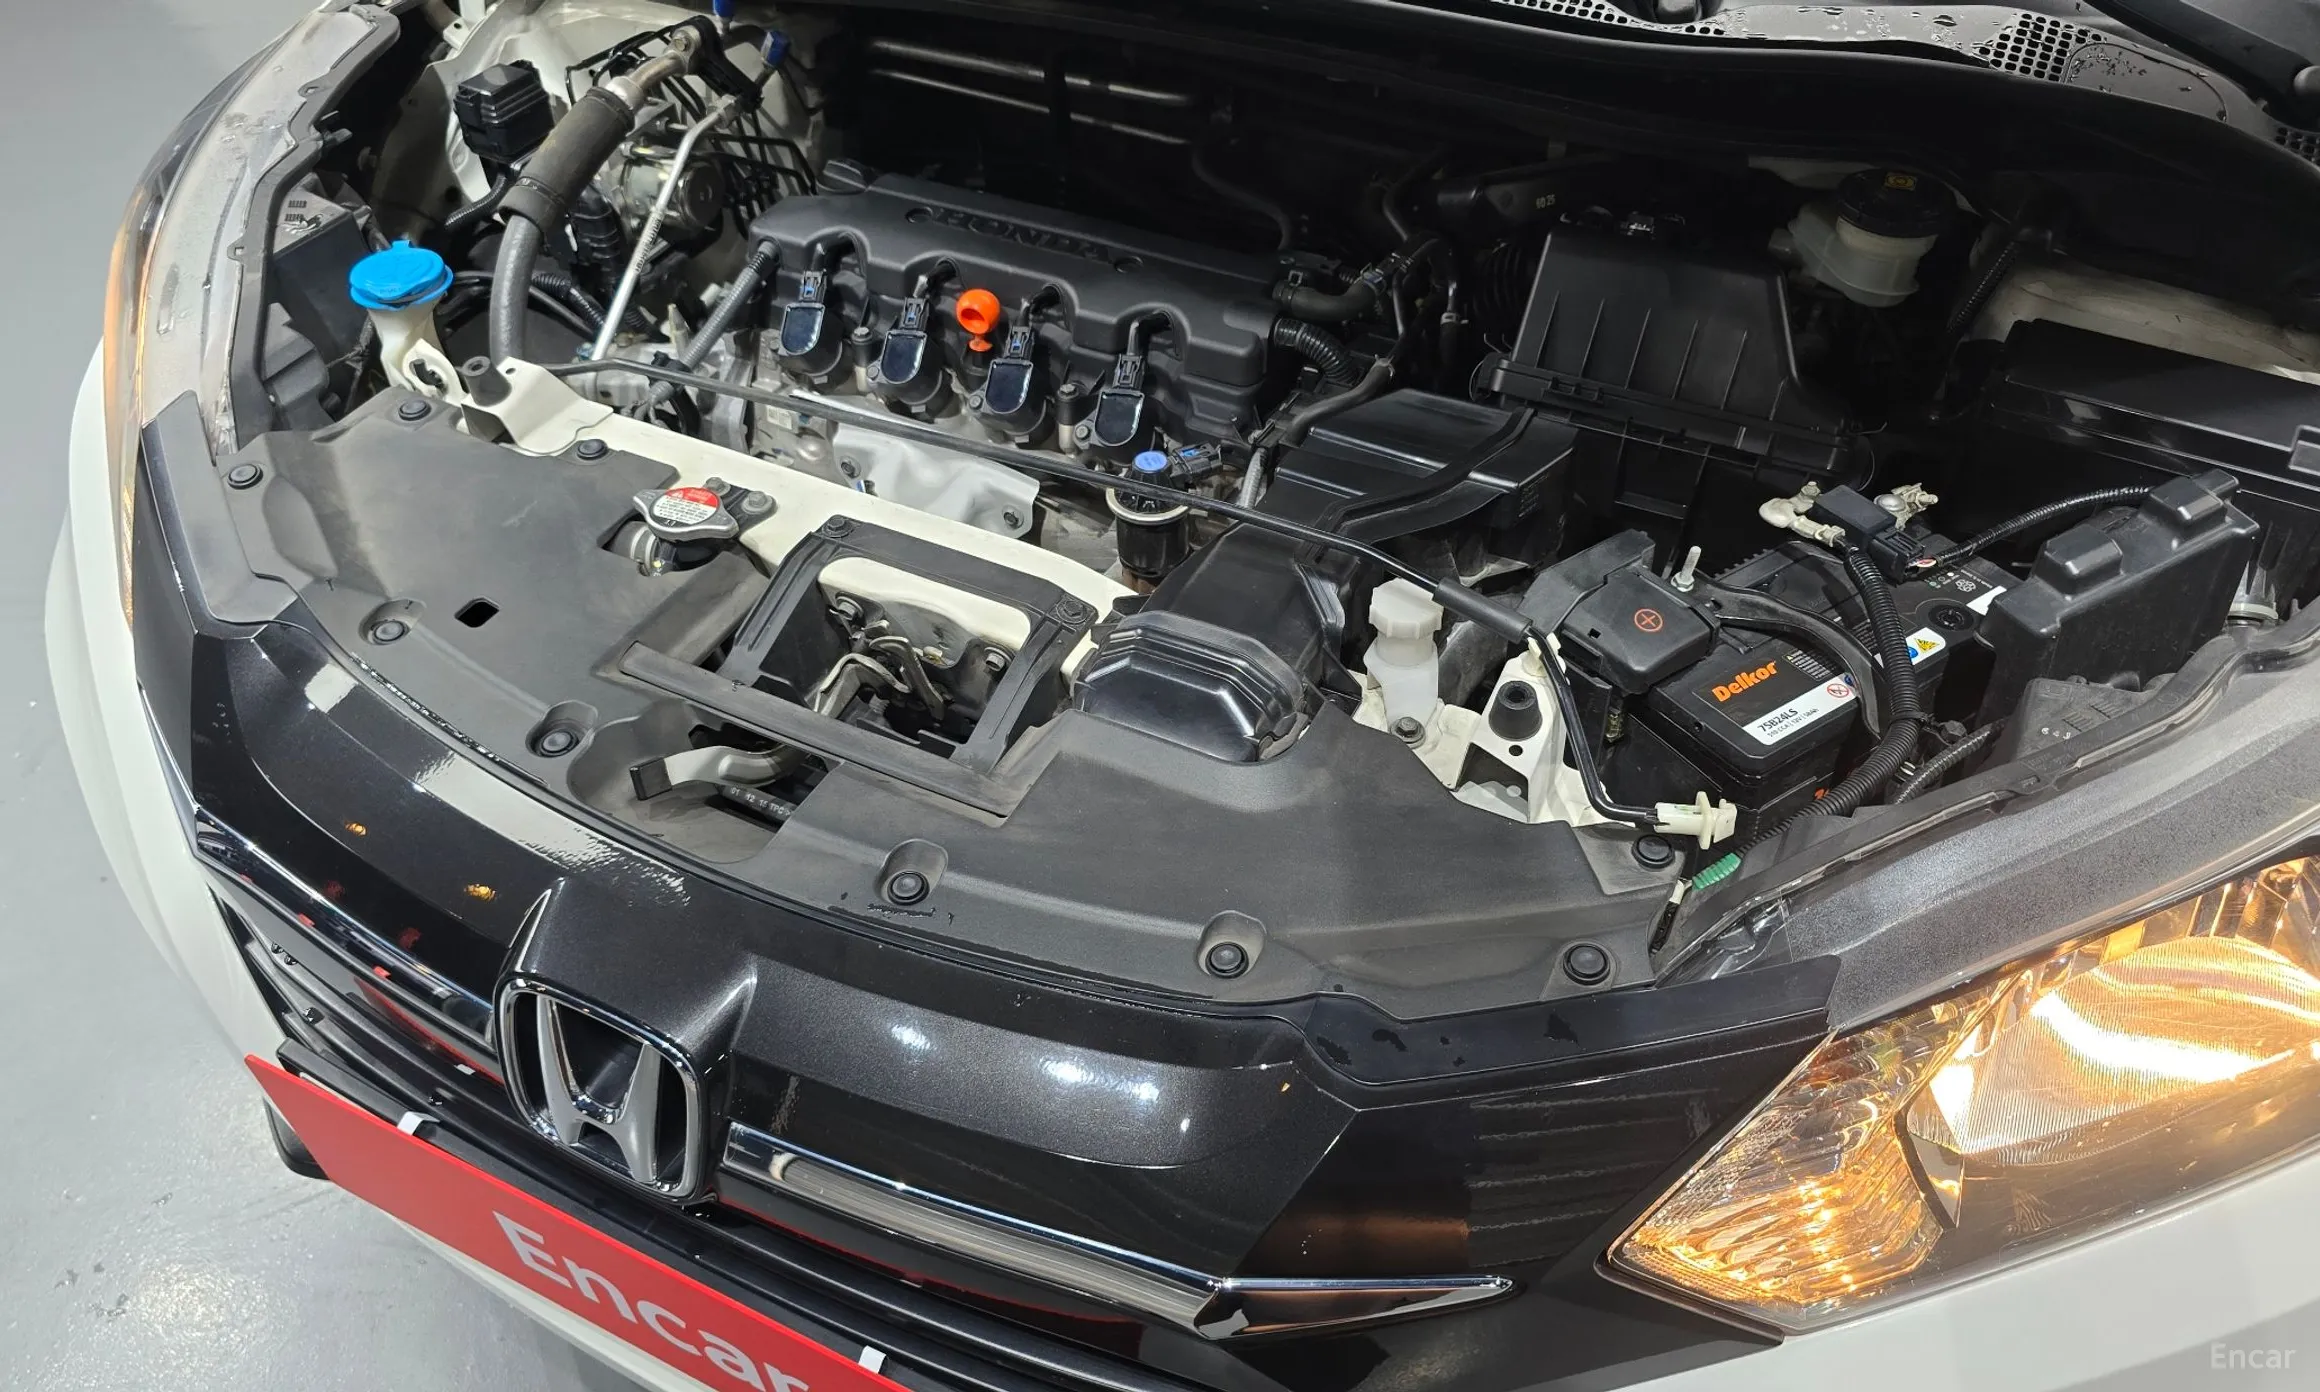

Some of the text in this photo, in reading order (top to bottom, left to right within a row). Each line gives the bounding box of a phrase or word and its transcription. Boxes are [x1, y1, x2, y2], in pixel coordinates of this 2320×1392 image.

[932, 206, 1112, 264] HONDA
[1711, 660, 1777, 702] Delkor
[1757, 708, 1798, 731] 75B24LS
[491, 1209, 810, 1392] Encar
